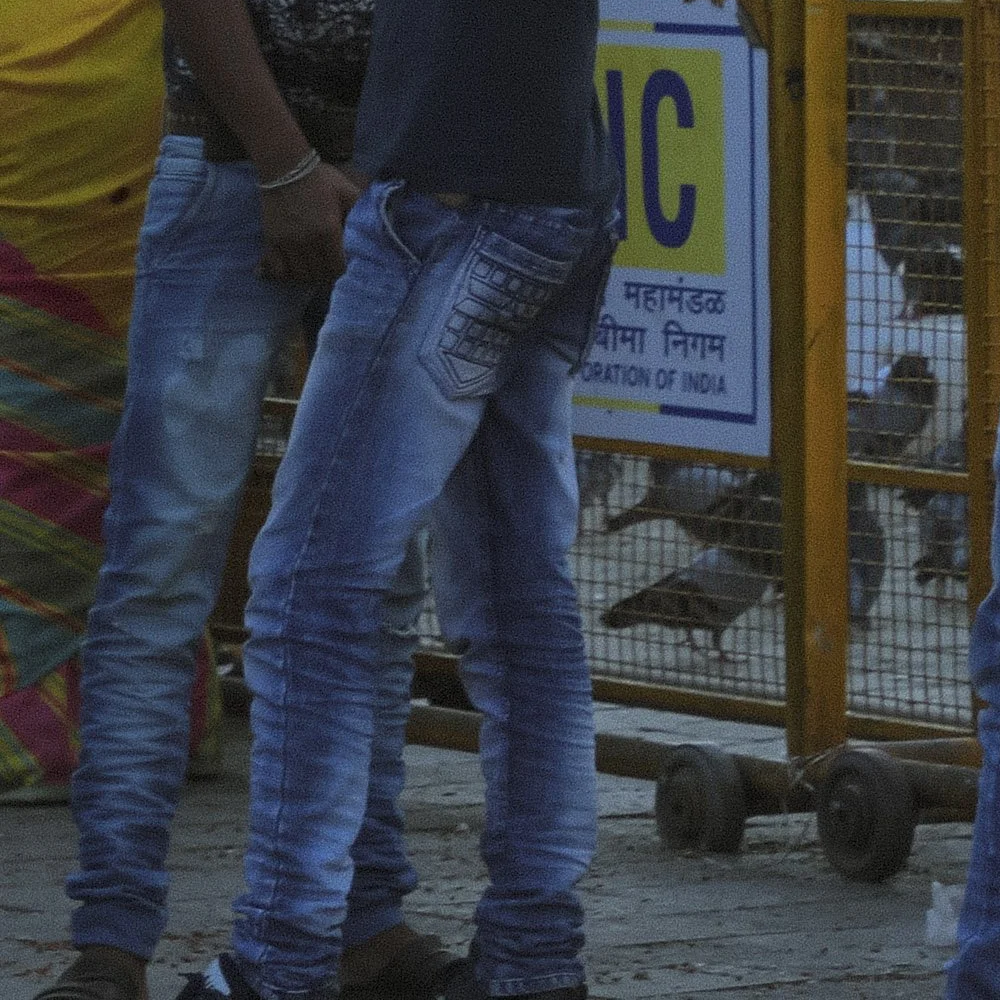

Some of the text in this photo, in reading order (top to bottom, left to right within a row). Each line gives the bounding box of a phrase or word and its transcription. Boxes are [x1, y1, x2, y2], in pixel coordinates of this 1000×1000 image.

[623, 277, 726, 315] महामंडळ
[662, 320, 726, 362] निगम
[656, 367, 676, 389] OF
[683, 371, 726, 394] INDIA
